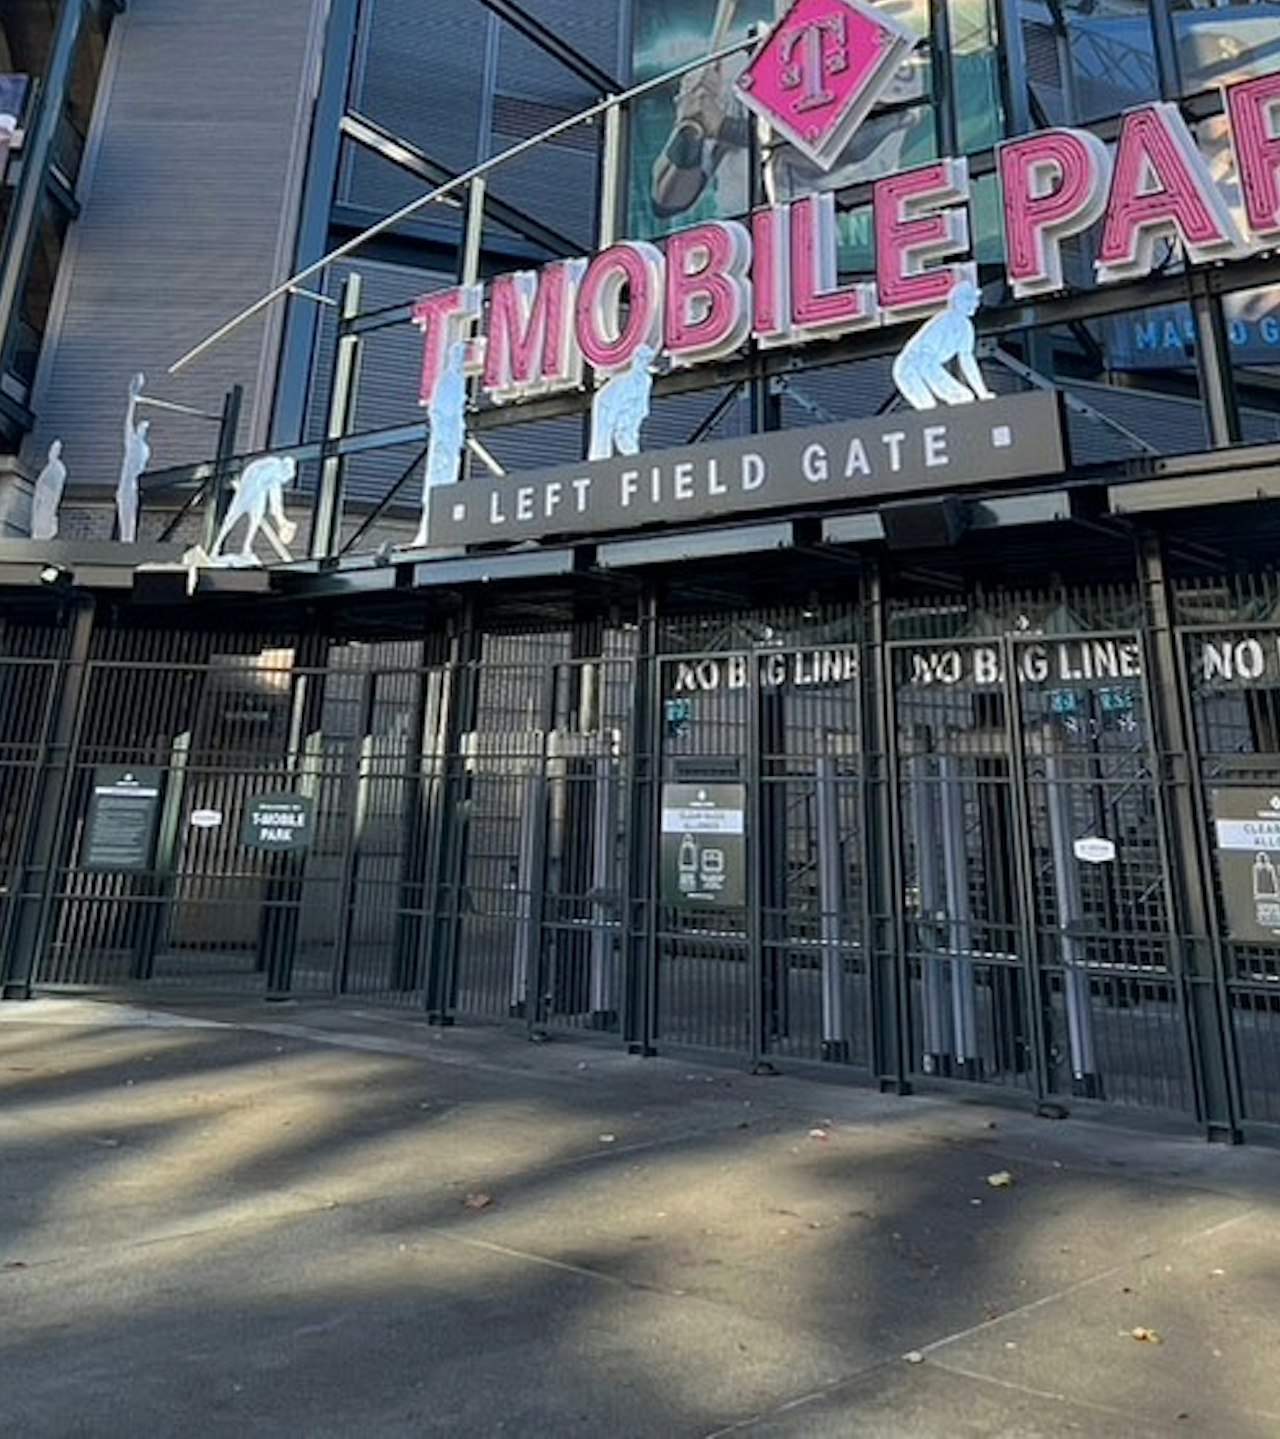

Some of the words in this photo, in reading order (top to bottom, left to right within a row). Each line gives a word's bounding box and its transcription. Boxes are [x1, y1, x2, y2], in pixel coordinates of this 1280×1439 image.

[779, 12, 849, 113] T
[412, 158, 977, 408] T-MOBILE
[489, 478, 591, 524] LEFT
[621, 452, 766, 508] FIELD
[802, 425, 950, 483] GATE
[674, 661, 720, 692] NO
[910, 650, 962, 684] NO
[1057, 639, 1142, 680] LINE
[1201, 636, 1265, 680] NO
